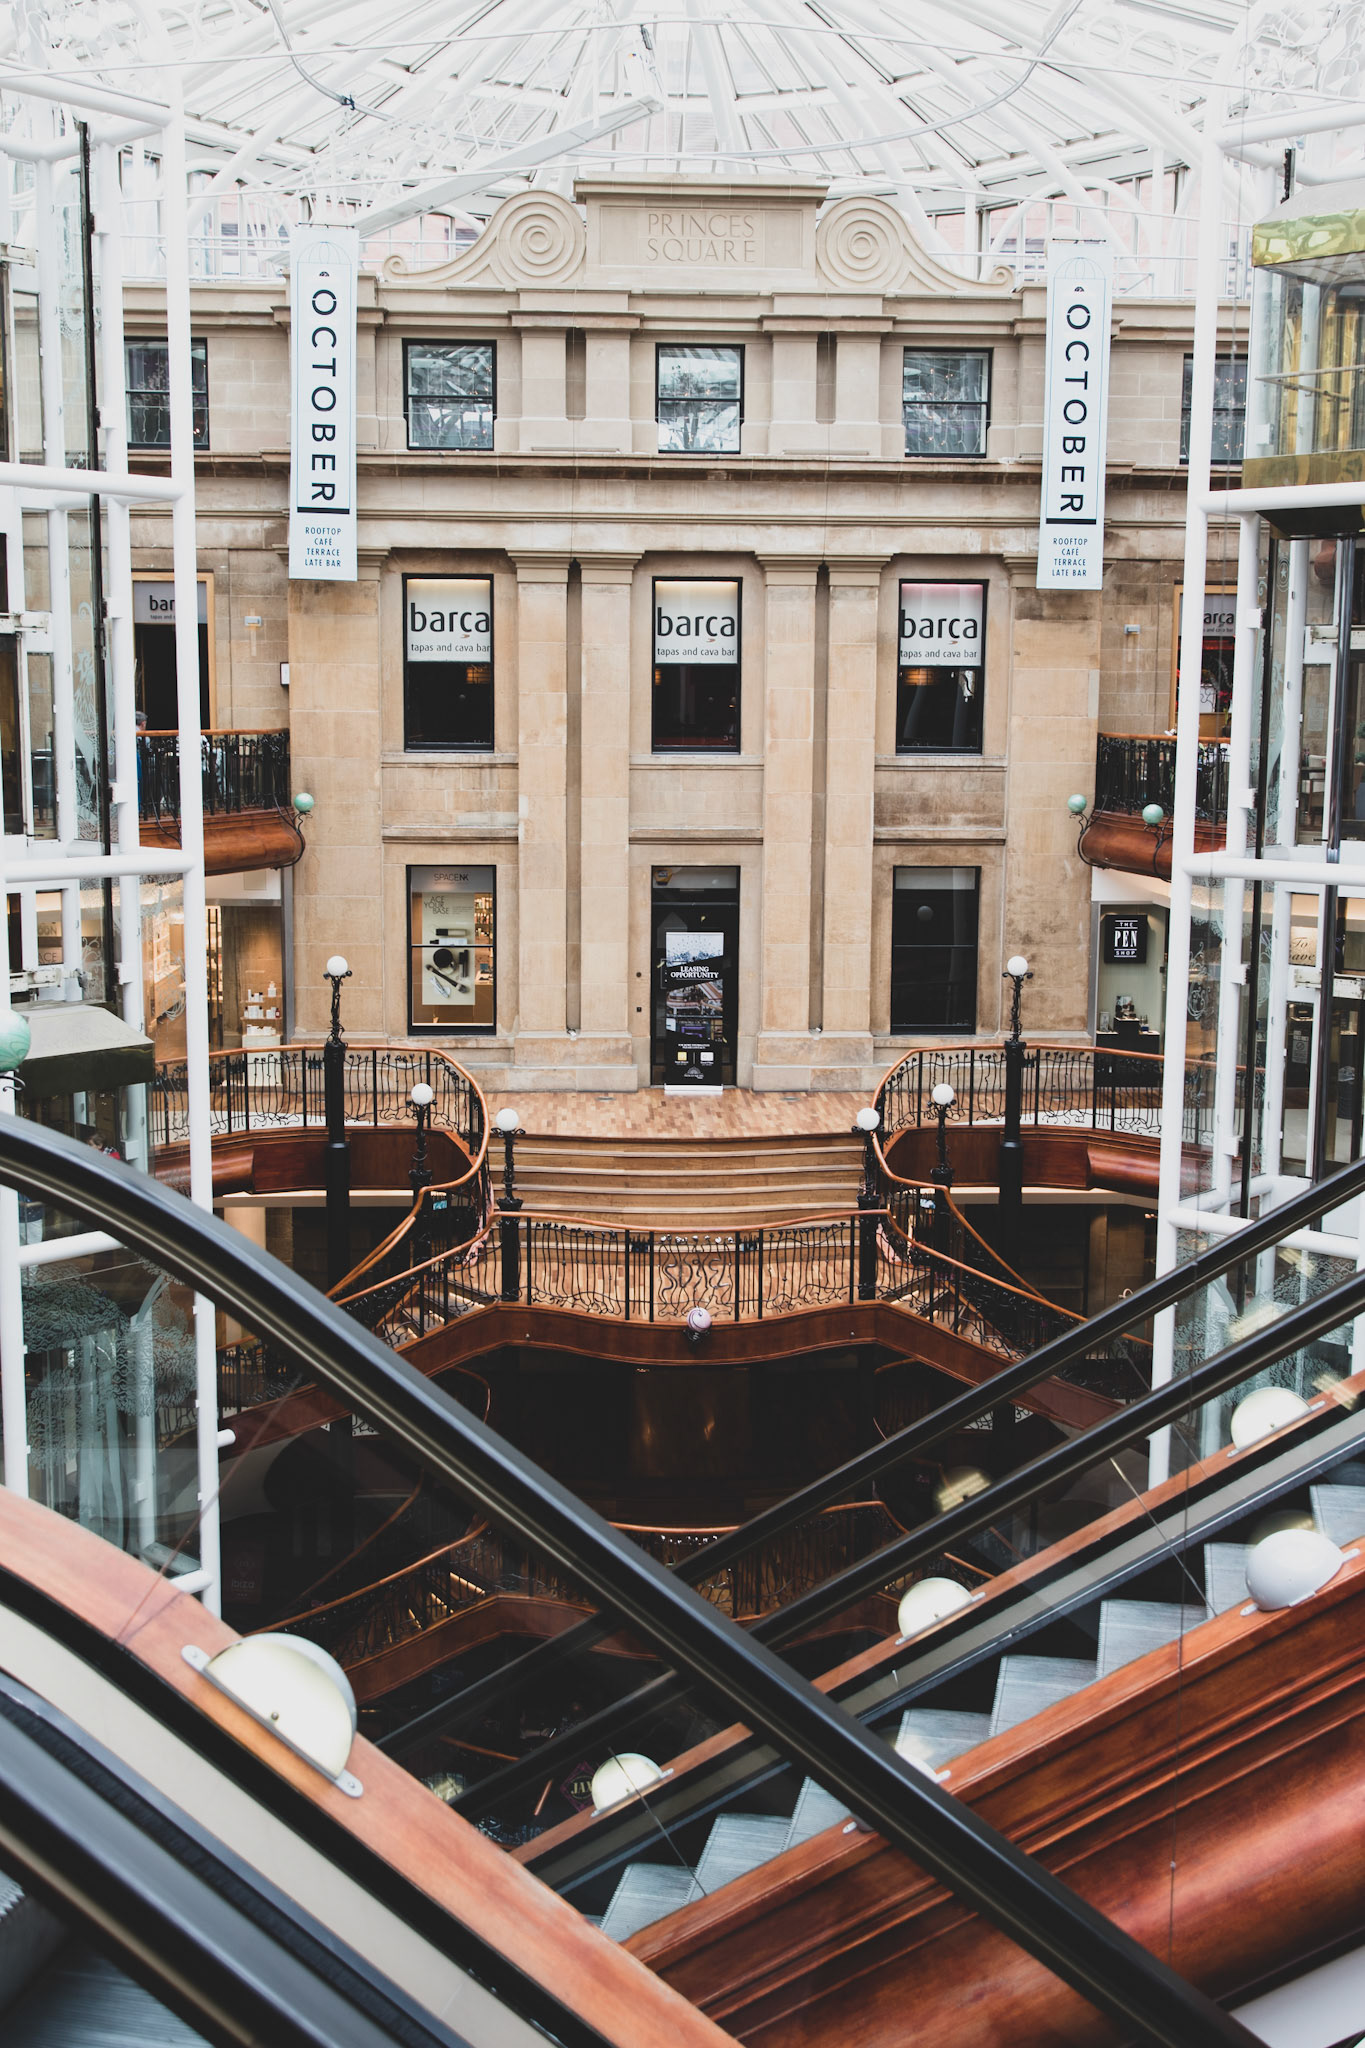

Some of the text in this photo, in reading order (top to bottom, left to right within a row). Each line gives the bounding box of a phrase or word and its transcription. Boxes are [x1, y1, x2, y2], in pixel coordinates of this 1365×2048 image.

[648, 213, 754, 238] PRINCES
[646, 238, 756, 262] SQUARE
[311, 289, 337, 501] OCTOBER
[1060, 304, 1091, 512] OCTOBER
[305, 526, 342, 535] ROOFTOP
[314, 536, 332, 546] CAFÉ
[1053, 538, 1088, 546] ROOFTOP
[307, 548, 340, 557] TERRACE
[1061, 547, 1079, 556] CAFÉ
[305, 559, 341, 567] LATE BAR
[1054, 558, 1086, 567] TERRACE
[1052, 569, 1087, 577] LATE BAR
[149, 595, 175, 611] bar
[1203, 612, 1235, 628] arça
[411, 643, 433, 653] tapas
[436, 643, 452, 652] and
[476, 643, 490, 652] bar
[657, 648, 735, 657] tapas and cava bar
[900, 650, 921, 659] tapas
[924, 650, 940, 658] and
[964, 650, 977, 658] bar
[1114, 930, 1138, 947] PEN
